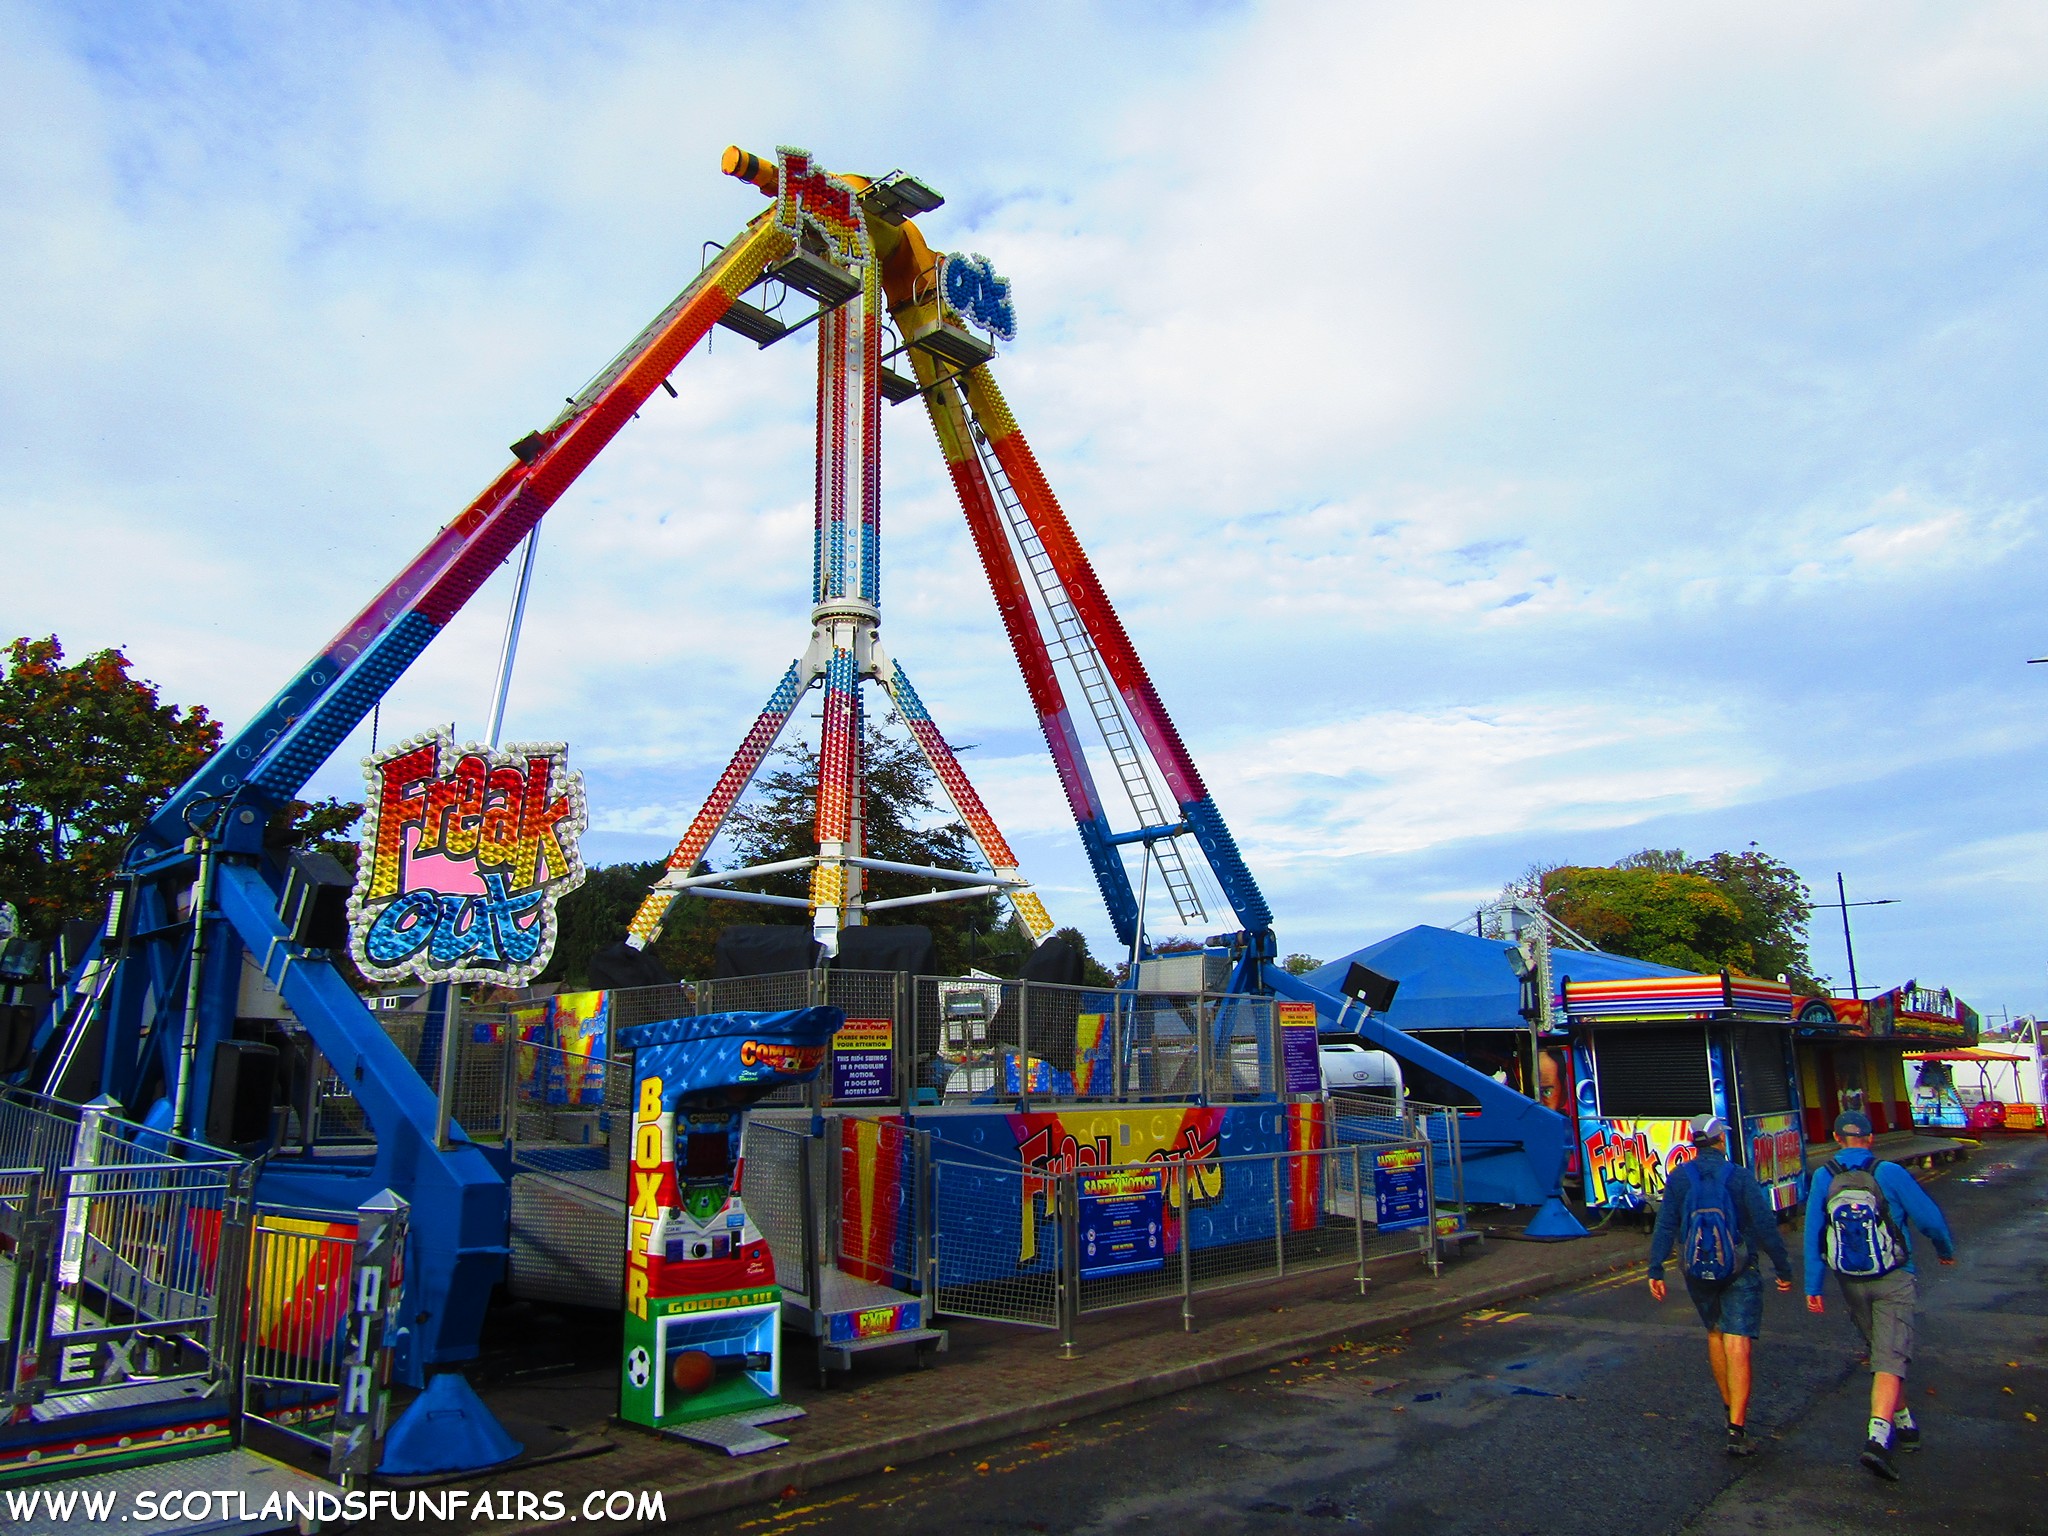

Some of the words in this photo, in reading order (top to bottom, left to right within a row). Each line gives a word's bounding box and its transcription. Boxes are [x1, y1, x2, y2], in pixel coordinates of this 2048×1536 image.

[363, 743, 570, 902] Freak
[365, 872, 544, 964] out
[628, 1076, 664, 1321] BOXER
[1083, 1178, 1120, 1195] SAFETY
[1121, 1175, 1157, 1192] NOTICE!
[346, 1266, 382, 1413] AIR
[668, 1292, 772, 1314] GOOOAL!!!
[859, 1309, 894, 1331] EXIT
